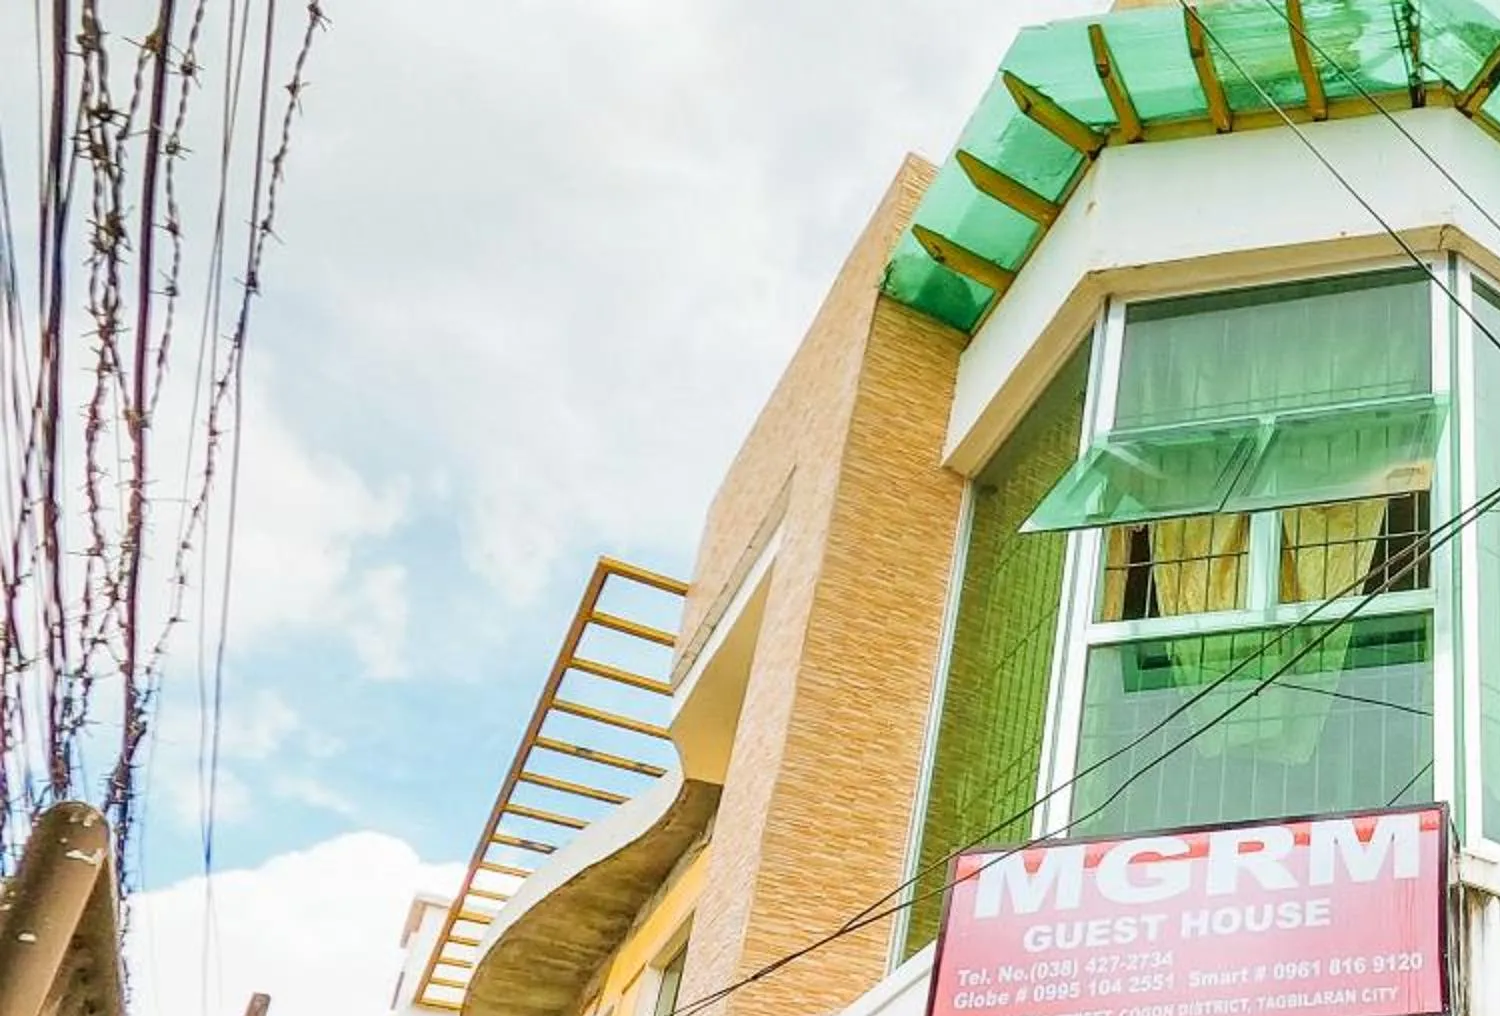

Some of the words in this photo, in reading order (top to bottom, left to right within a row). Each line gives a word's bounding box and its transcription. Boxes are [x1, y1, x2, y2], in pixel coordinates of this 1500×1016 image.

[973, 813, 1421, 919] MGRM
[1024, 914, 1168, 953] GUEST
[1181, 898, 1331, 938] HOUSE
[954, 991, 1009, 1010] Globe
[1015, 986, 1027, 1001] #
[1033, 981, 1080, 1001] 0995
[1089, 978, 1122, 996] 104
[1129, 973, 1175, 993] 2551
[1188, 969, 1250, 988] Smart
[1254, 964, 1268, 979] #
[1273, 959, 1323, 980] 0961
[1329, 956, 1367, 976] 816
[1374, 952, 1423, 973] 9120
[957, 968, 992, 987] Tel.
[1085, 951, 1173, 974] 427-2734
[1257, 988, 1357, 1010] TAGBILARAN
[1362, 986, 1399, 1003] CITY
